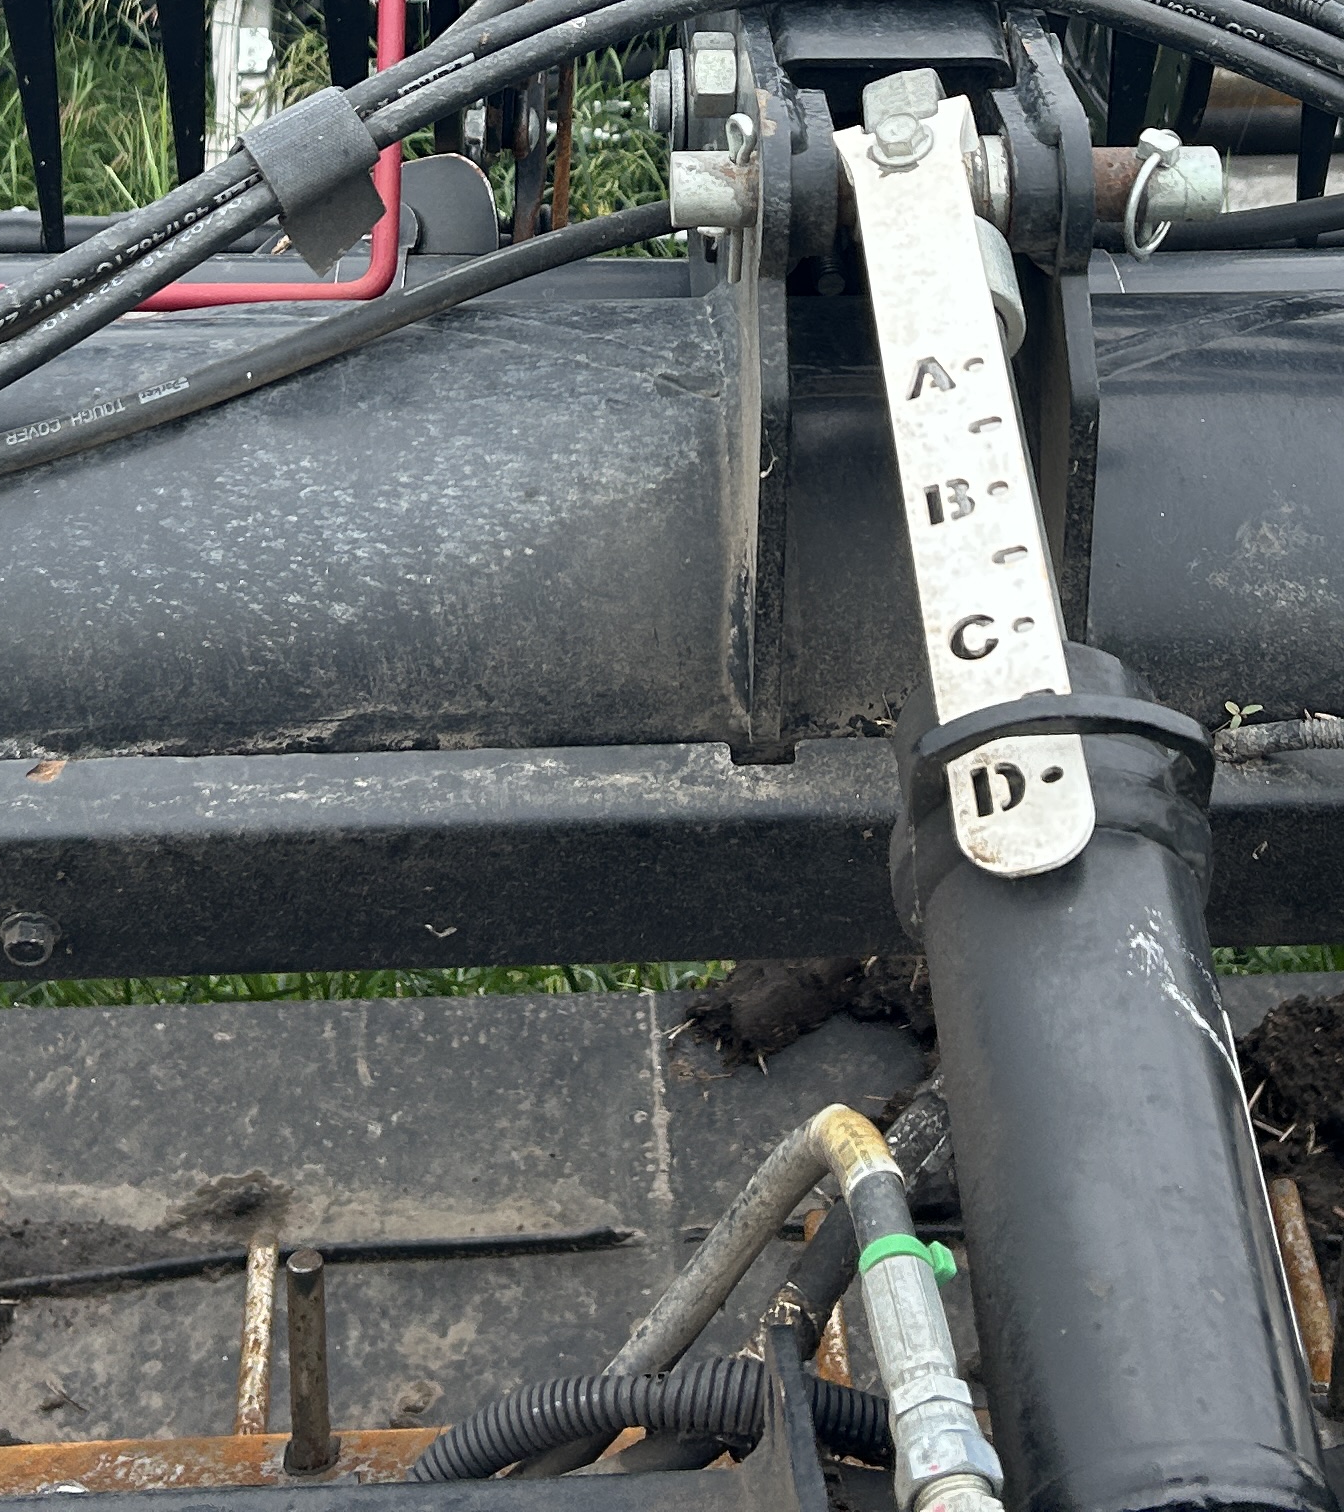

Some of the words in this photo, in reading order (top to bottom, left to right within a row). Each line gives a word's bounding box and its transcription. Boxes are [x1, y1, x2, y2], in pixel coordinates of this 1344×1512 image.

[906, 356, 956, 401] A
[2, 416, 63, 447] COVER
[68, 396, 126, 427] TOUGH
[922, 477, 976, 526] B
[949, 613, 999, 660] C
[969, 761, 1026, 818] D
